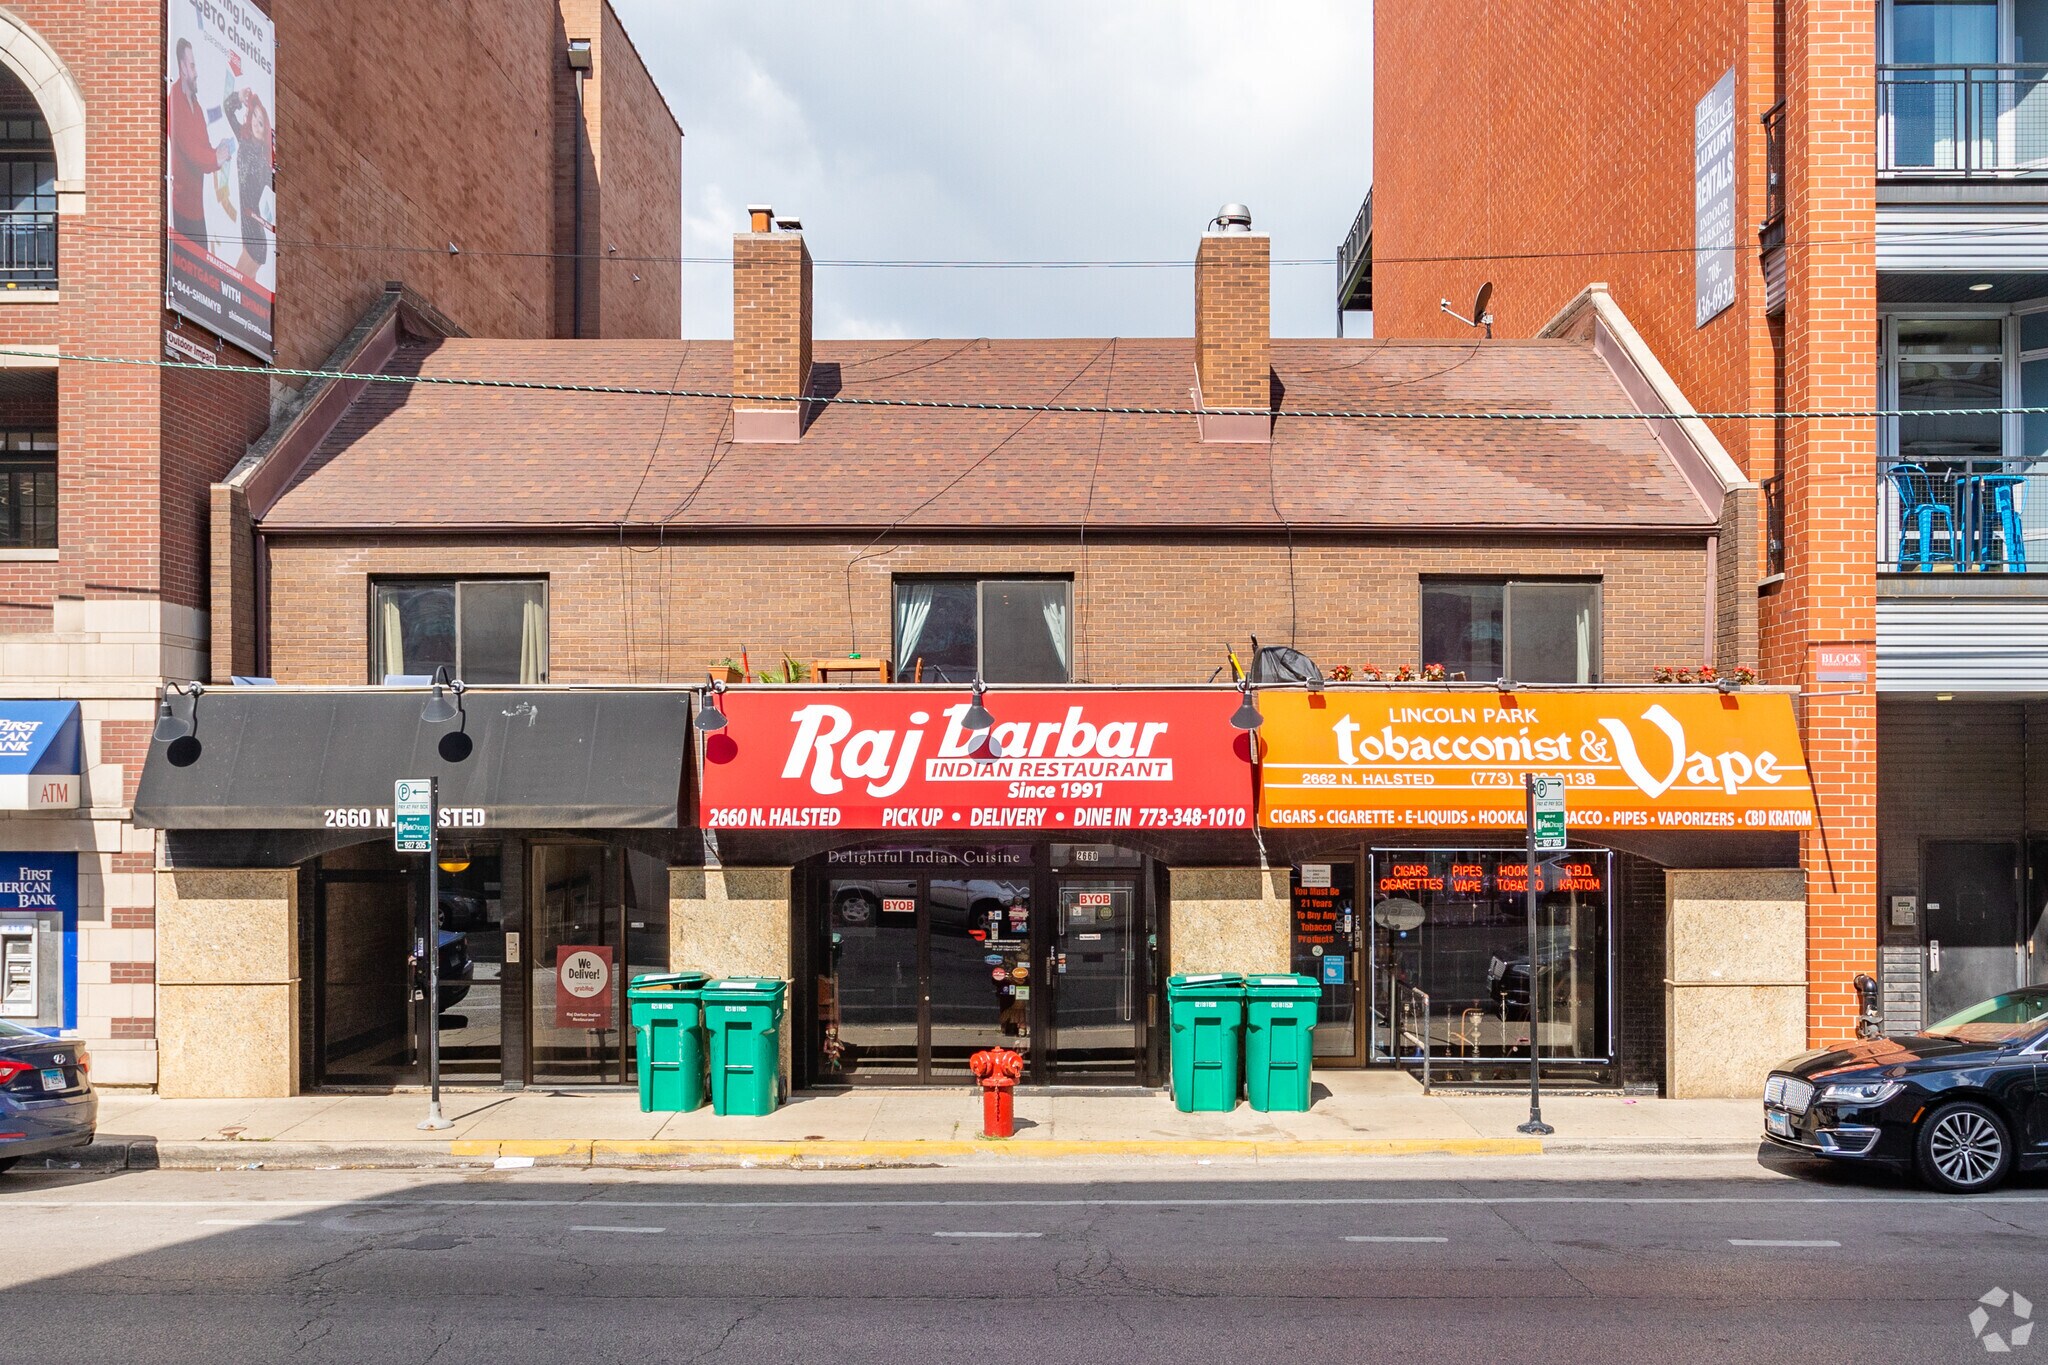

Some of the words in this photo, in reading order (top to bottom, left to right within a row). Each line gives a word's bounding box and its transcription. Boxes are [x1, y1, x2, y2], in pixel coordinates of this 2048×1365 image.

[241, 8, 263, 42] love
[227, 25, 272, 76] charities
[1696, 92, 1713, 120] THE
[1696, 95, 1733, 144] SOLSTICE
[1696, 121, 1733, 173] LUXURY
[1696, 150, 1733, 212] RENTALS
[1700, 197, 1729, 232] INDOOR
[1698, 213, 1730, 249] PARKING
[1696, 228, 1734, 270] AVAILABLE
[172, 251, 220, 293] MORTGAGE
[220, 281, 241, 304] WITH
[1696, 275, 1734, 322] 436-6932
[167, 332, 193, 353] Outdoor
[193, 345, 215, 364] Impact
[1821, 653, 1861, 663] BLOCK
[1389, 708, 1476, 723] LINCOLN
[1484, 708, 1539, 723] PARK
[781, 704, 930, 798] Raj
[937, 703, 1169, 758] Darbar
[1332, 713, 1572, 766] tobacconist
[1579, 729, 1613, 763] &
[1598, 704, 1783, 799] Vape
[931, 762, 1013, 778] INDIAN
[1018, 762, 1168, 777] RESTAURANT
[1302, 773, 1337, 785] 2662
[1341, 774, 1357, 785] N.
[1363, 773, 1435, 786] HALSTED
[1471, 771, 1513, 787] (773)
[41, 783, 68, 802] ATM
[1007, 781, 1056, 799] Since
[1060, 781, 1103, 798] 1991
[324, 808, 371, 828] 2660
[376, 808, 396, 827] N.
[437, 808, 486, 828] STED
[708, 808, 747, 827] 2660
[749, 808, 766, 827] N.
[769, 808, 841, 827] HALSTED
[882, 808, 920, 827] PICK
[921, 808, 943, 827] UP
[970, 808, 1047, 827] DELIVERY
[1073, 808, 1112, 826] DINE
[1114, 808, 1132, 826] IN
[1138, 807, 1246, 827] 773-348-1010
[1270, 809, 1316, 824] CIGARS
[1326, 809, 1395, 824] CIGARETTE
[1405, 809, 1468, 825] E-LIQUIDS
[1478, 809, 1527, 825] HOOKA
[1564, 810, 1603, 825] BACCO
[1613, 810, 1647, 825] PIPES
[1657, 811, 1735, 827] VAPORIZERS
[1744, 810, 1766, 826] CBD
[1768, 810, 1812, 826] KRATOM
[828, 850, 903, 866] Delightful
[910, 850, 957, 863] Indian
[963, 850, 1020, 863] Cuisine
[1077, 851, 1098, 861] 2660
[19, 867, 53, 881] FIRST
[1393, 864, 1429, 877] CIGARS
[1452, 864, 1483, 877] PIPES
[1499, 864, 1541, 877] HOOKH
[0, 882, 51, 893] ERICAN
[1294, 887, 1308, 896] You
[1310, 887, 1328, 896] Must
[1329, 887, 1340, 896] Be
[1380, 878, 1443, 891] CIGARETTES
[1453, 879, 1482, 892] VAPE
[1496, 878, 1544, 891] TOBACO
[1559, 878, 1600, 890] KRATOM
[18, 894, 57, 908] BANK
[884, 900, 914, 911] BYOB
[1080, 894, 1111, 905] BYOB
[1301, 899, 1310, 908] 21
[1311, 899, 1332, 908] Years
[1296, 911, 1305, 919] To
[1307, 911, 1321, 921] Buy
[1322, 911, 1337, 921] Any
[1301, 923, 1332, 931] Tobacco
[1298, 935, 1334, 944] Products
[578, 958, 591, 968] We
[568, 968, 600, 980] Deliver!
